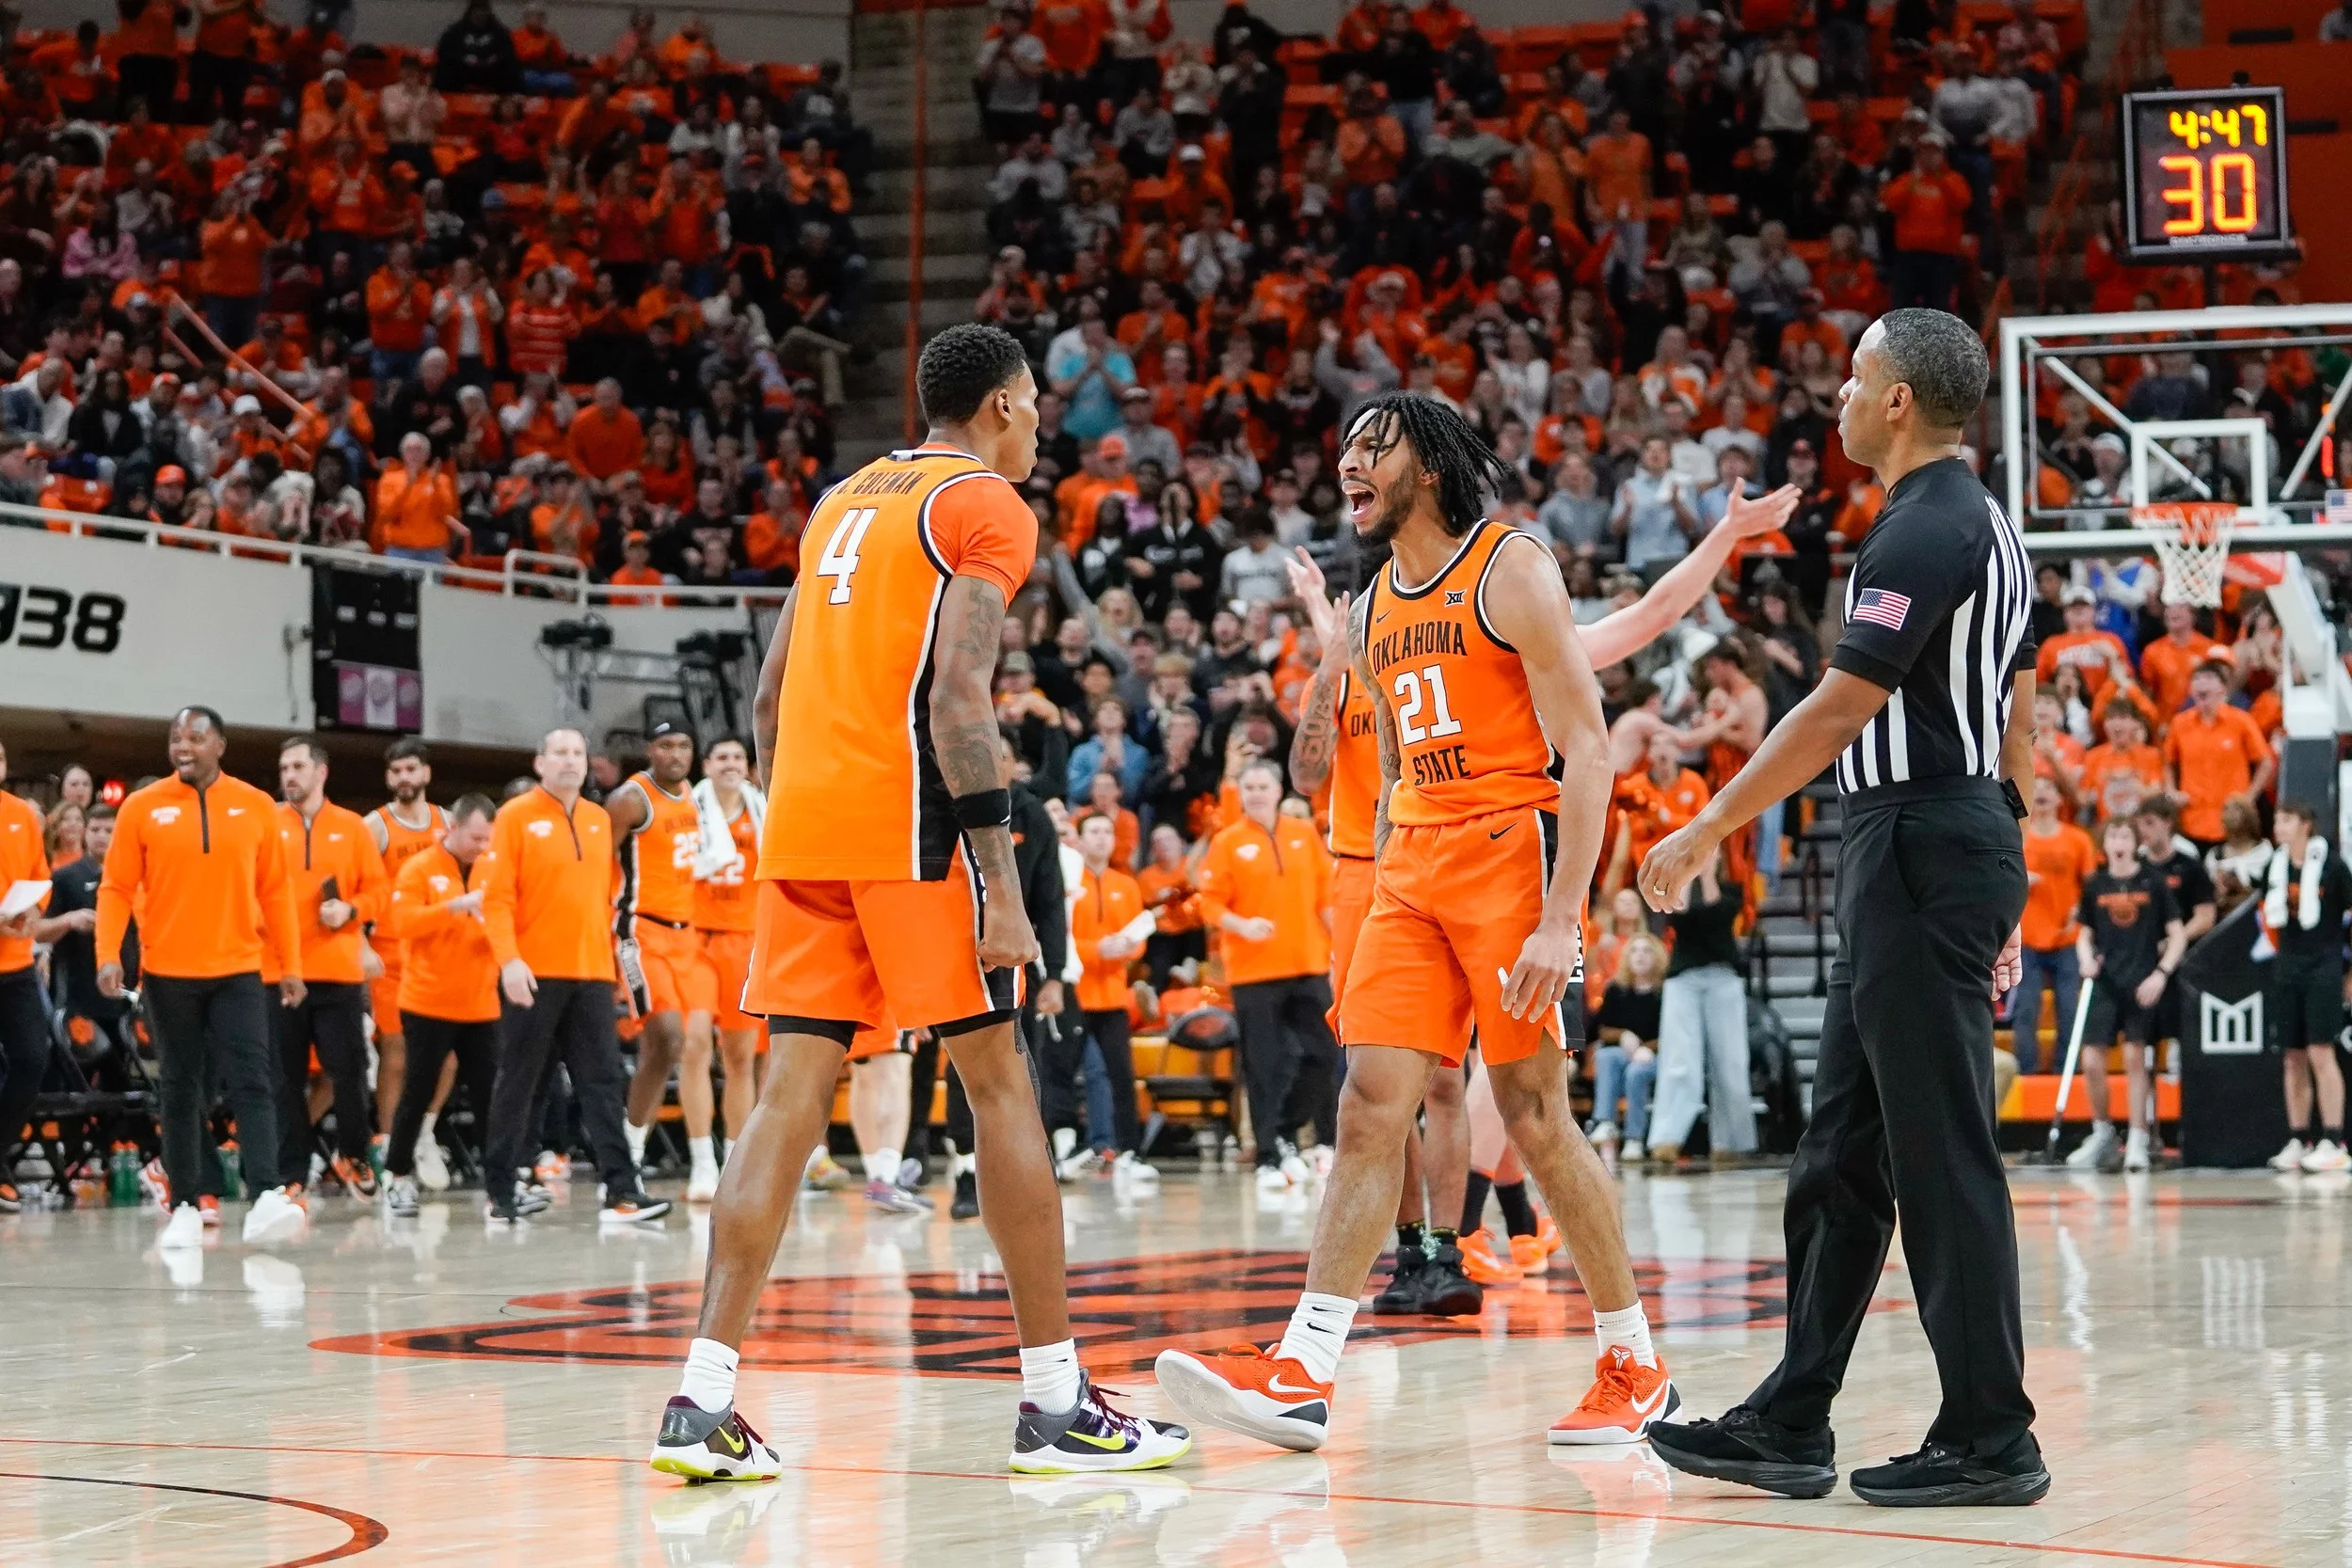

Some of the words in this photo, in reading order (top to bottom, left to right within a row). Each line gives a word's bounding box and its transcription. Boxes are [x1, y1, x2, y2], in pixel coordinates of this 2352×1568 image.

[2169, 104, 2267, 150] 4:47
[2158, 152, 2258, 235] 30
[852, 471, 928, 495] COLEMAN
[817, 507, 879, 605] 4
[1373, 621, 1468, 676] OKLAHOMA
[1393, 663, 1462, 746] 21
[1412, 745, 1470, 786] STATE
